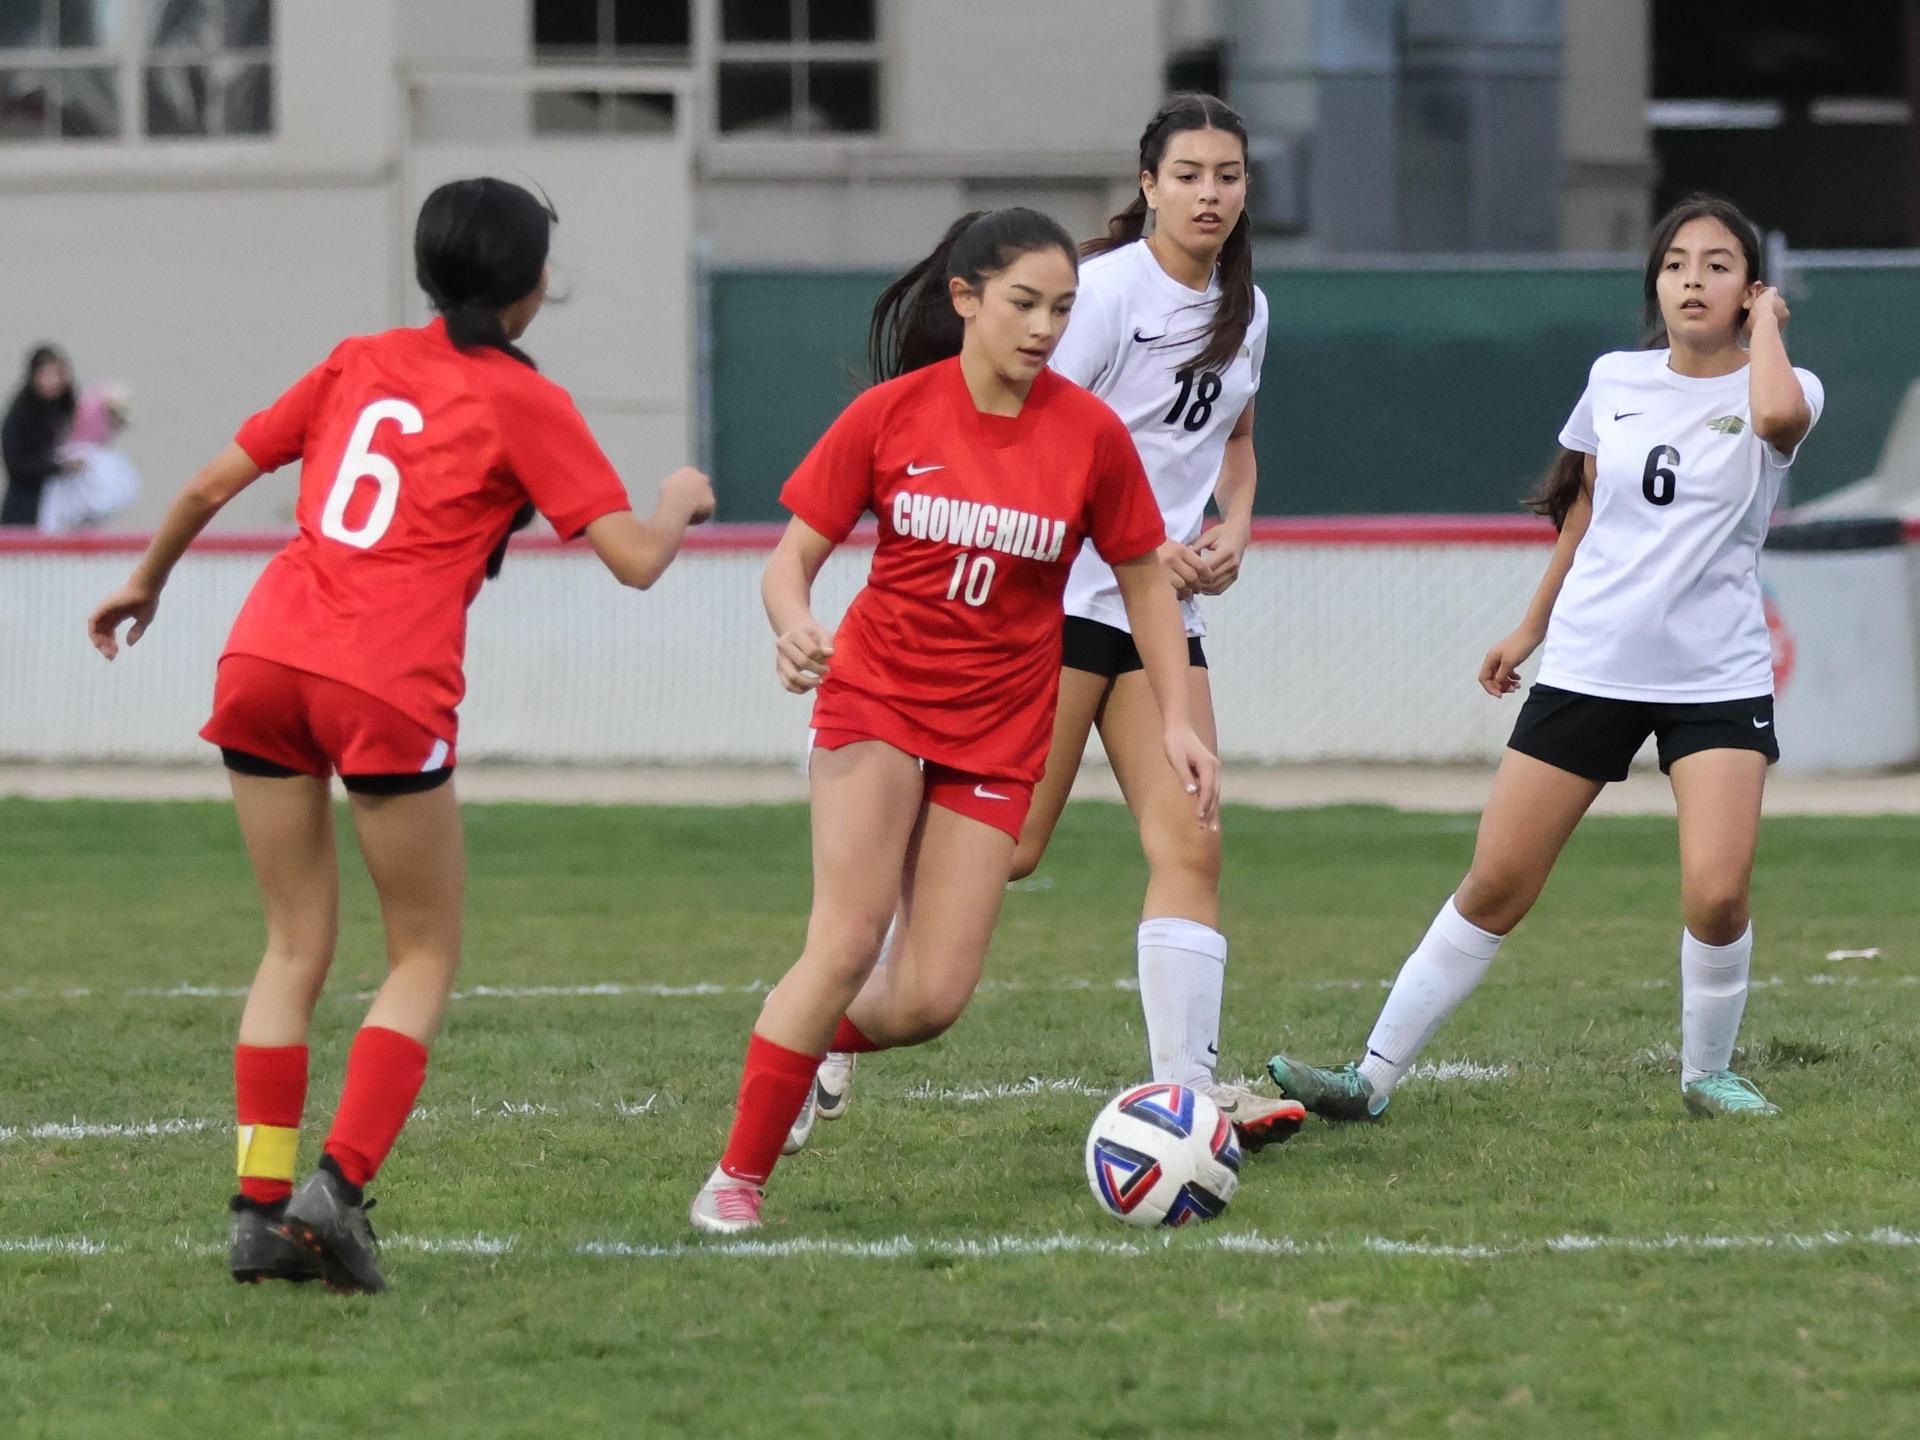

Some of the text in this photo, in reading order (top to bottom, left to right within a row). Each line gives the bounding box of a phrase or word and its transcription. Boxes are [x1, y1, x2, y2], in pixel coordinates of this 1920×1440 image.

[1163, 367, 1222, 432] 18
[320, 398, 425, 549] 6
[1642, 444, 1681, 506] 6
[892, 491, 1067, 562] CHOWCHILLA
[946, 552, 996, 607] 10
